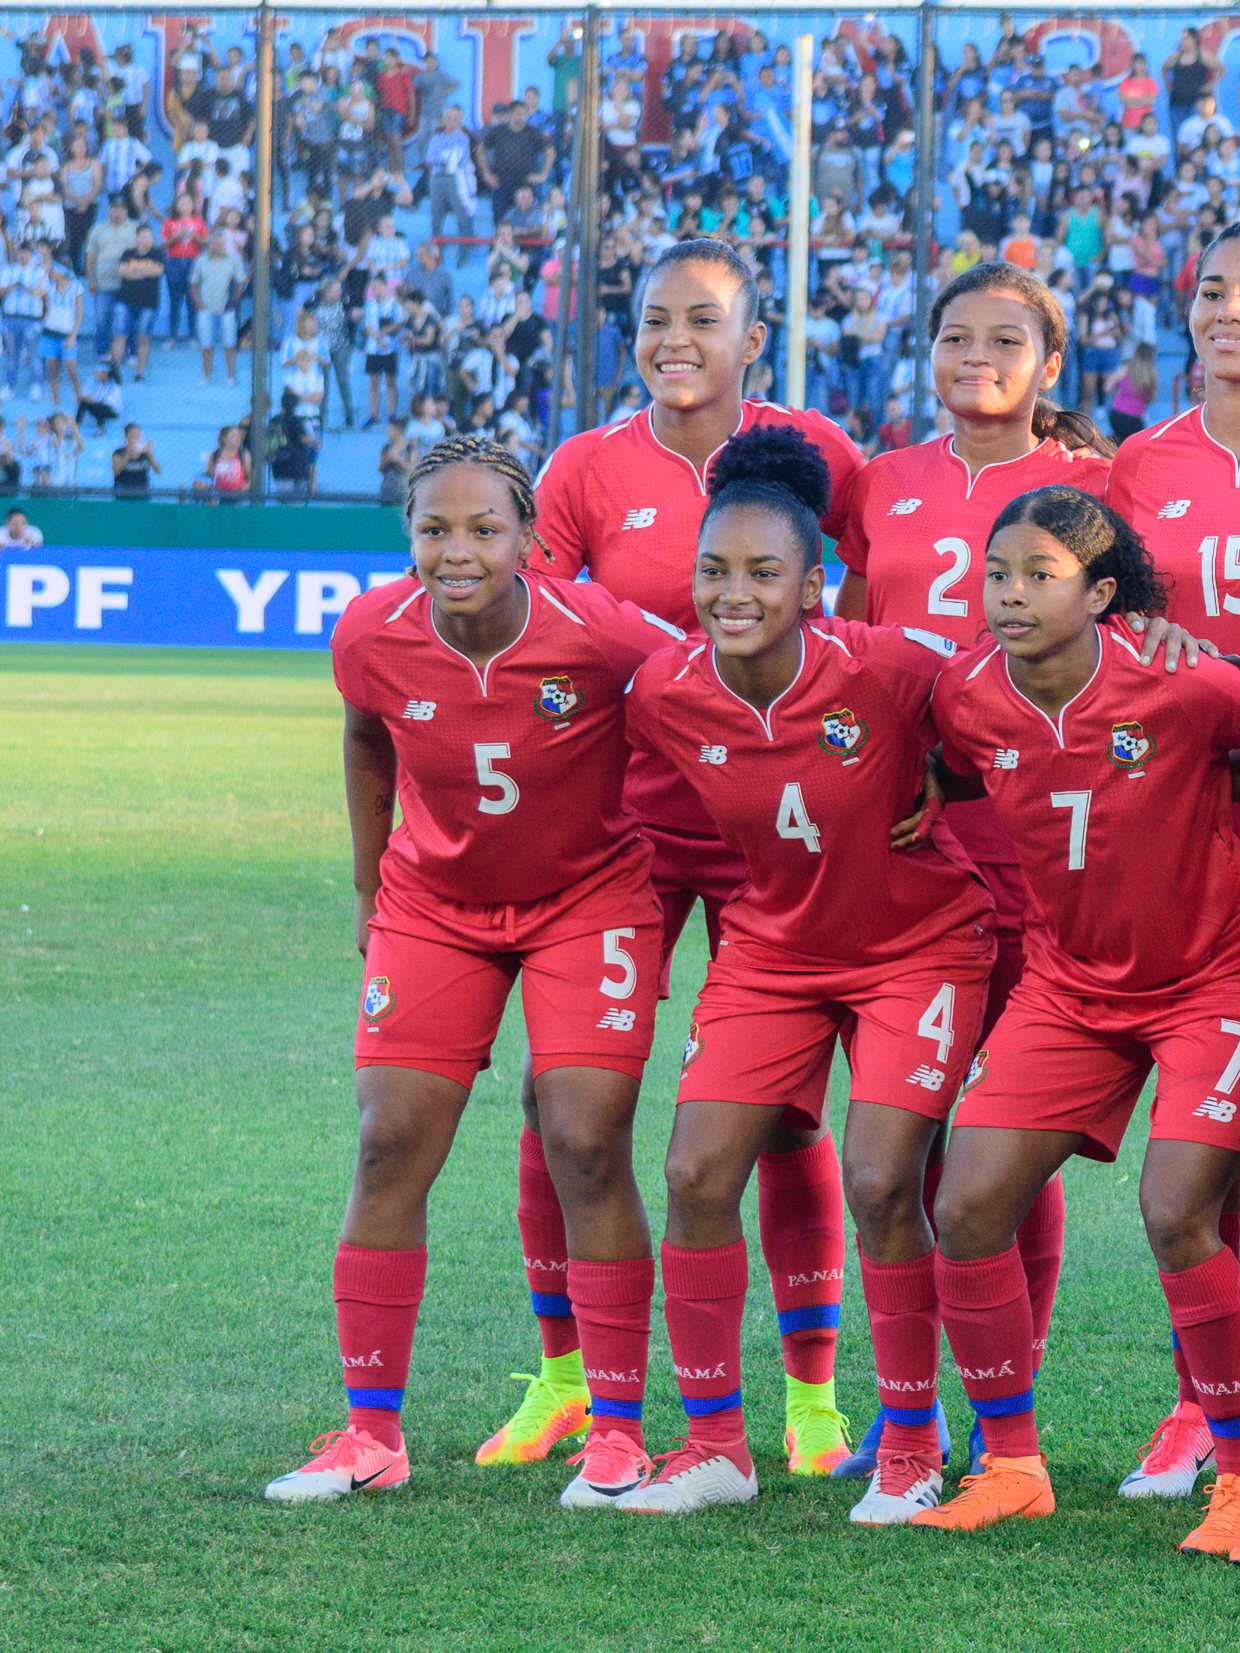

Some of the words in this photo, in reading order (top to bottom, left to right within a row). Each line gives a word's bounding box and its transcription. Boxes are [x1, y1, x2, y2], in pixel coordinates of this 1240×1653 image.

[215, 568, 413, 634] YP
[928, 537, 971, 617] 2
[474, 743, 520, 815] 5
[776, 782, 822, 853] 4
[1050, 790, 1093, 871] 7
[599, 926, 638, 1000] 5
[918, 982, 956, 1064] 4
